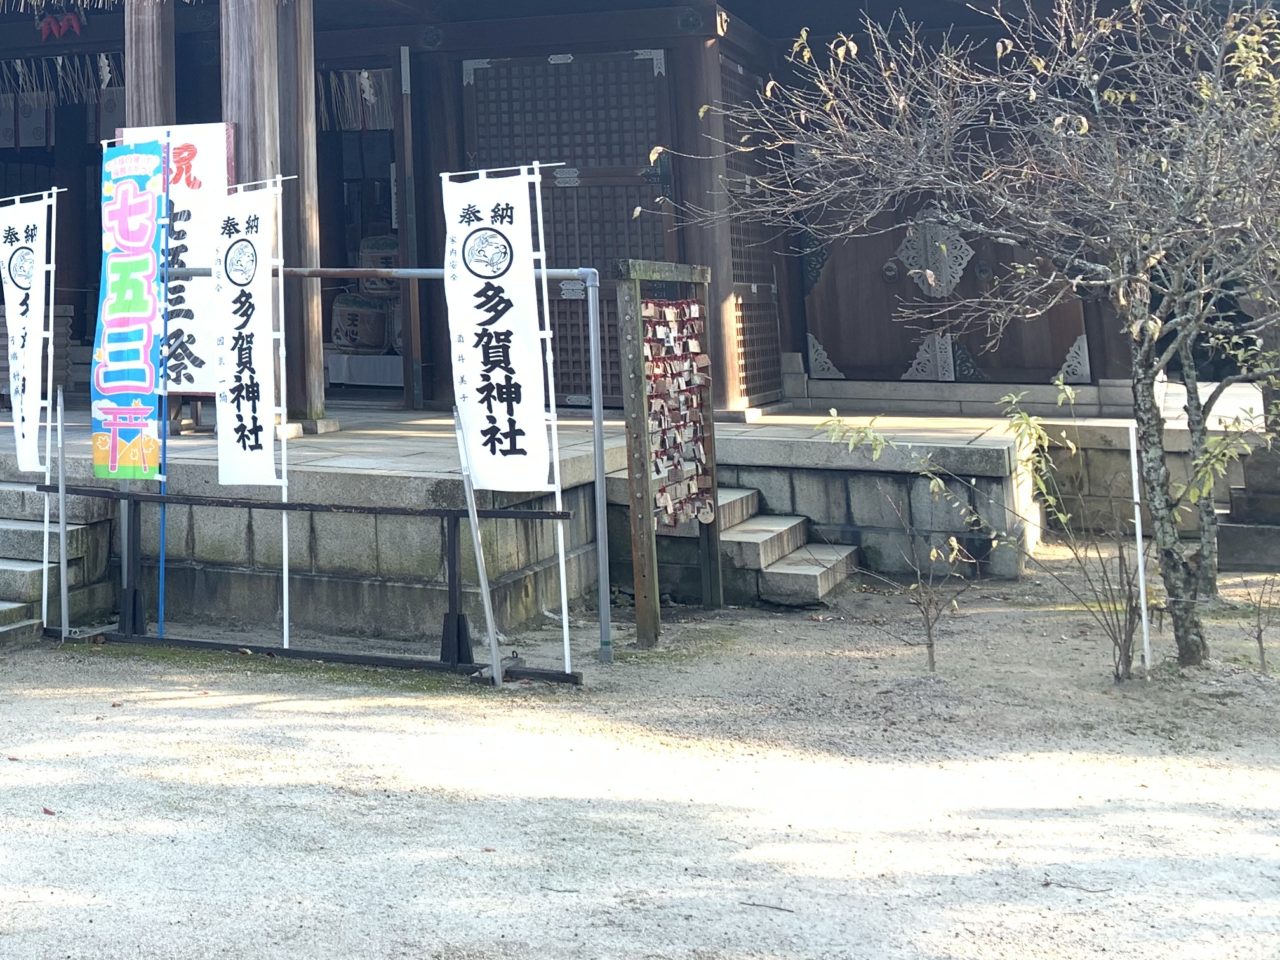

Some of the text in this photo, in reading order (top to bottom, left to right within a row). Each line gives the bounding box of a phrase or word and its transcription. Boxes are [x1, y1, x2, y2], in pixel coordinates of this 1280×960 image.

[2, 223, 38, 247] 奉納
[220, 214, 260, 239] 奉納
[459, 202, 514, 228] 奉納
[96, 180, 157, 396] 七五三
[229, 288, 264, 452] 多賀神社
[473, 281, 528, 457] 多賀神社
